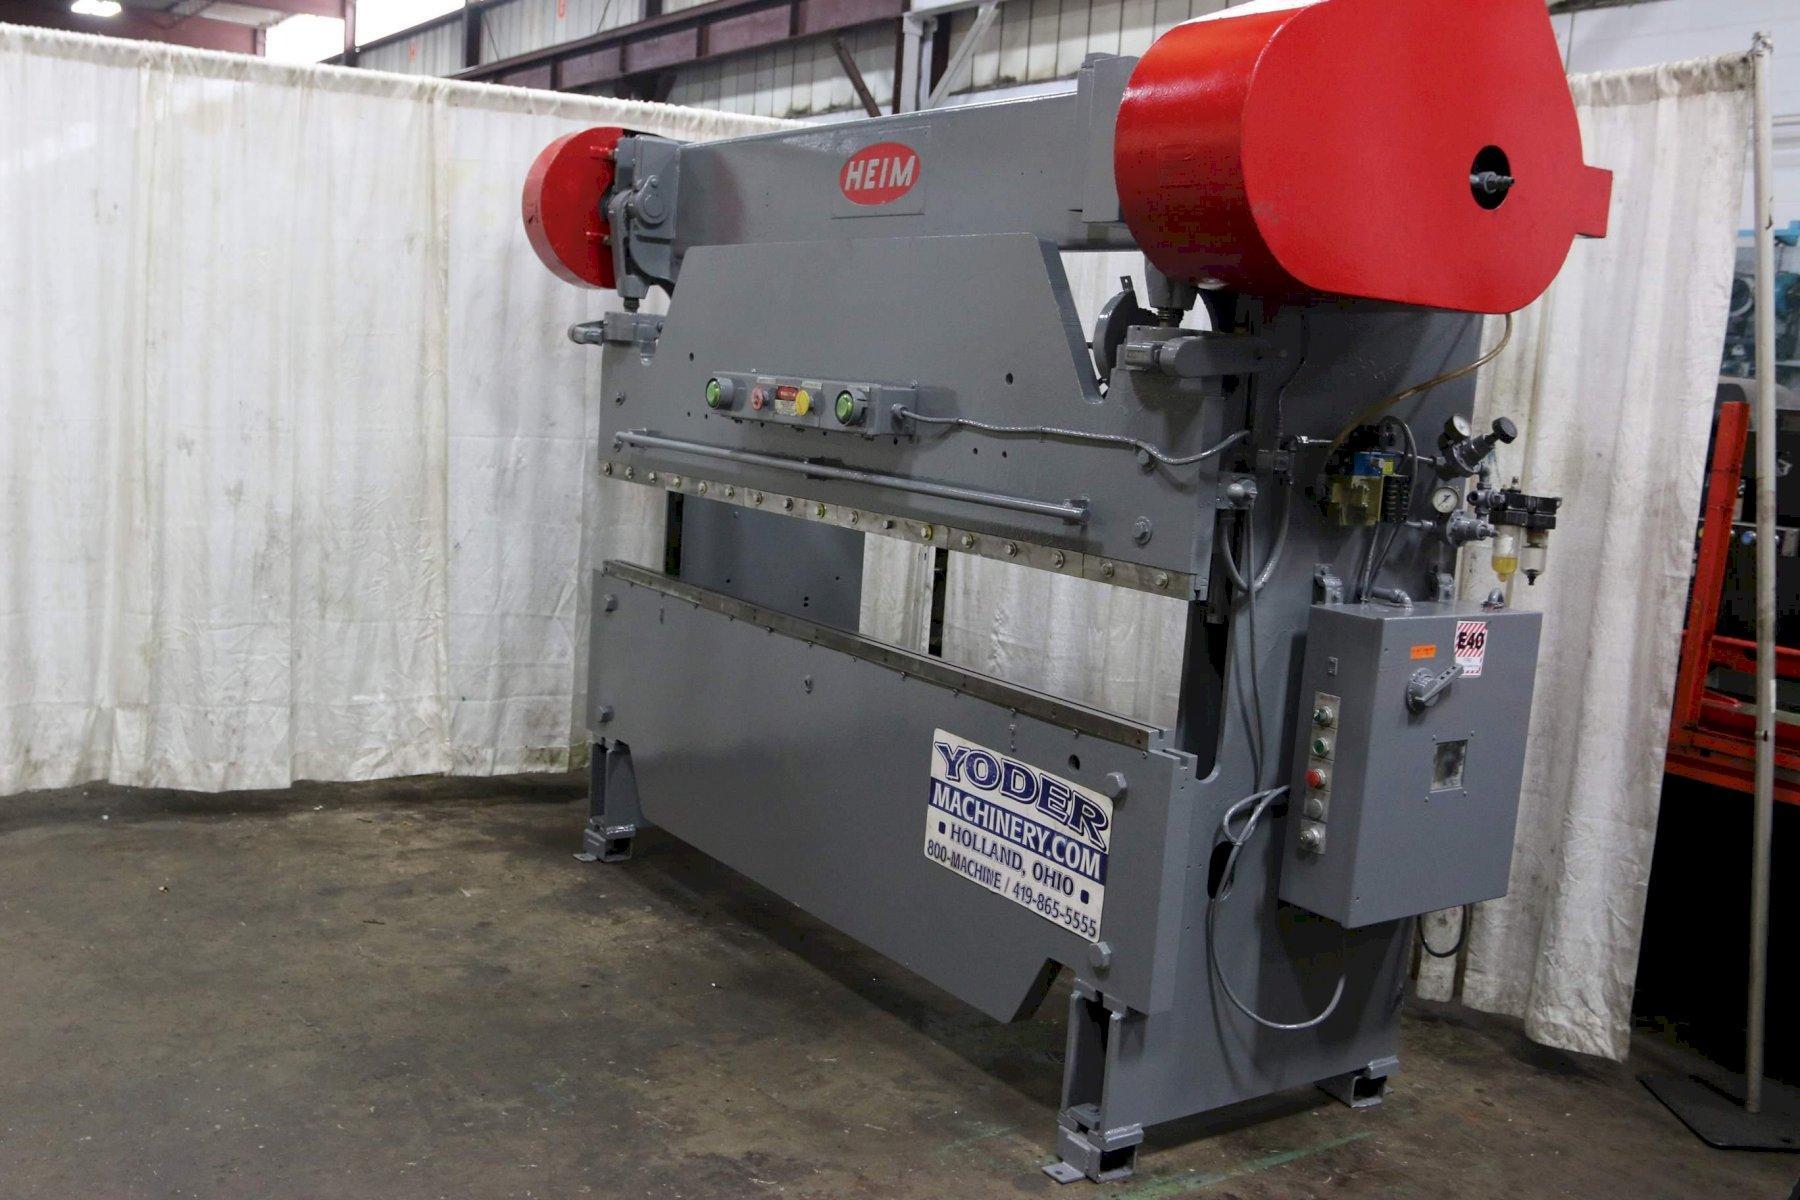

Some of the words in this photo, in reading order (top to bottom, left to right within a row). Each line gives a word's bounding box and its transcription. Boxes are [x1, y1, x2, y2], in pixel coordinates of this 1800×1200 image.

[844, 155, 916, 191] HEIM
[1457, 631, 1485, 650] E40
[932, 782, 1101, 880] MACHINERY.COM
[934, 741, 1109, 853] YODER
[927, 838, 1002, 889] 800-MACHINE
[1012, 882, 1097, 938] 419-865-5555
[950, 823, 1026, 877] HOLLAND,
[1032, 860, 1074, 897] OHIO
